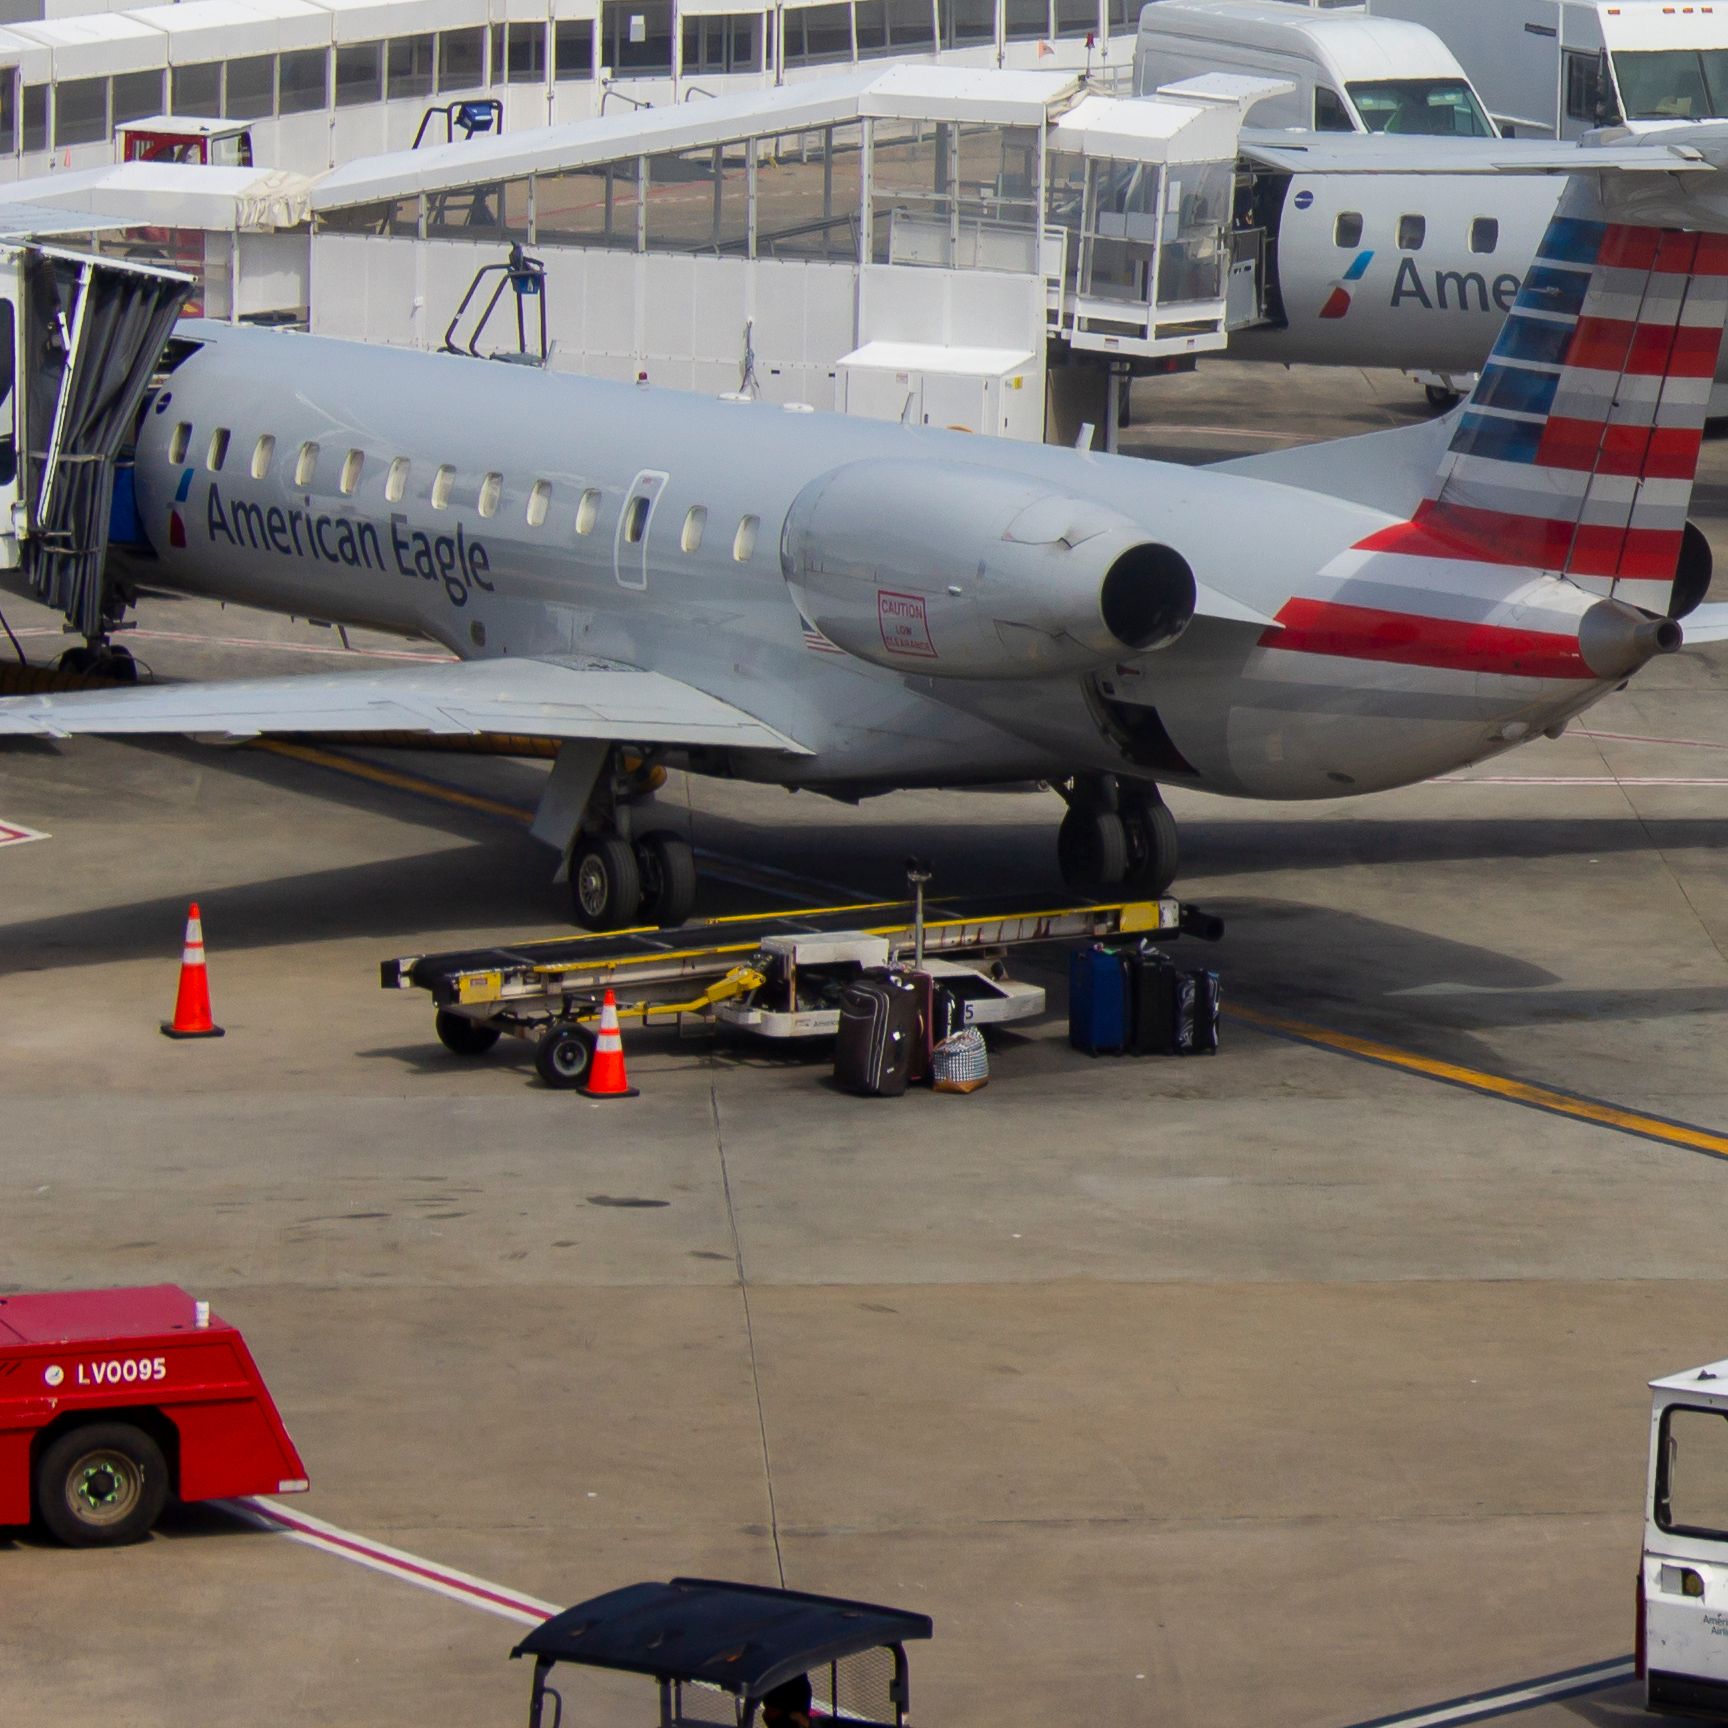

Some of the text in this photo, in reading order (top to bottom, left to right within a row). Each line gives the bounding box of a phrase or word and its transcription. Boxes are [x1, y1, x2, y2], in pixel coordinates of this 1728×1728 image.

[206, 482, 495, 607] American Eagle
[881, 599, 923, 619] CAUTION
[78, 1357, 166, 1385] LV0095
